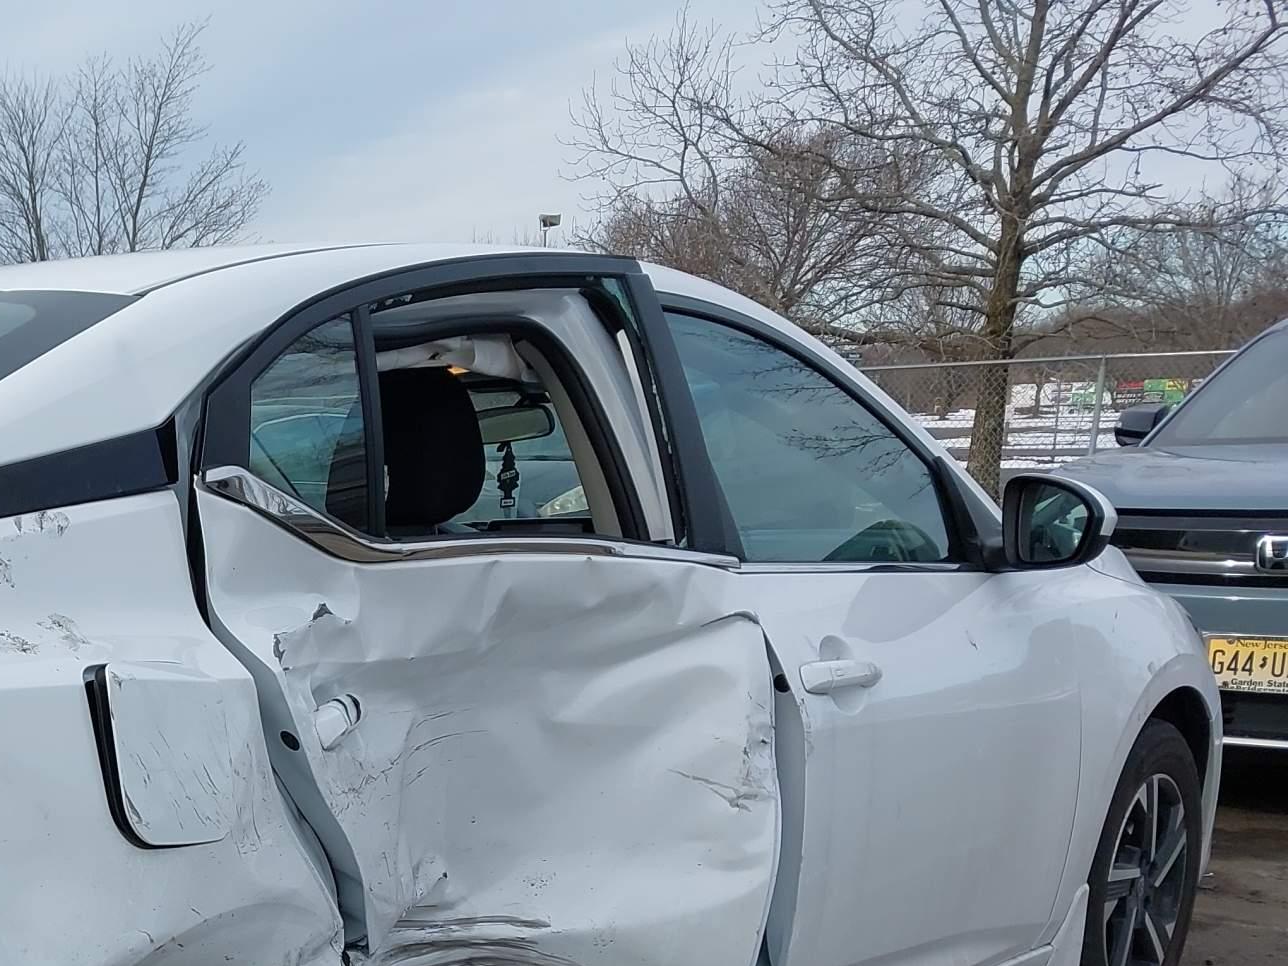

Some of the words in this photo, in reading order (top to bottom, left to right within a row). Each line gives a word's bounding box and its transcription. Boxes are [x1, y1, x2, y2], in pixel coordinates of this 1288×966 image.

[1261, 640, 1288, 650] Jerse
[1212, 649, 1255, 676] G44
[1271, 651, 1288, 677] U
[1231, 678, 1263, 687] Garden
